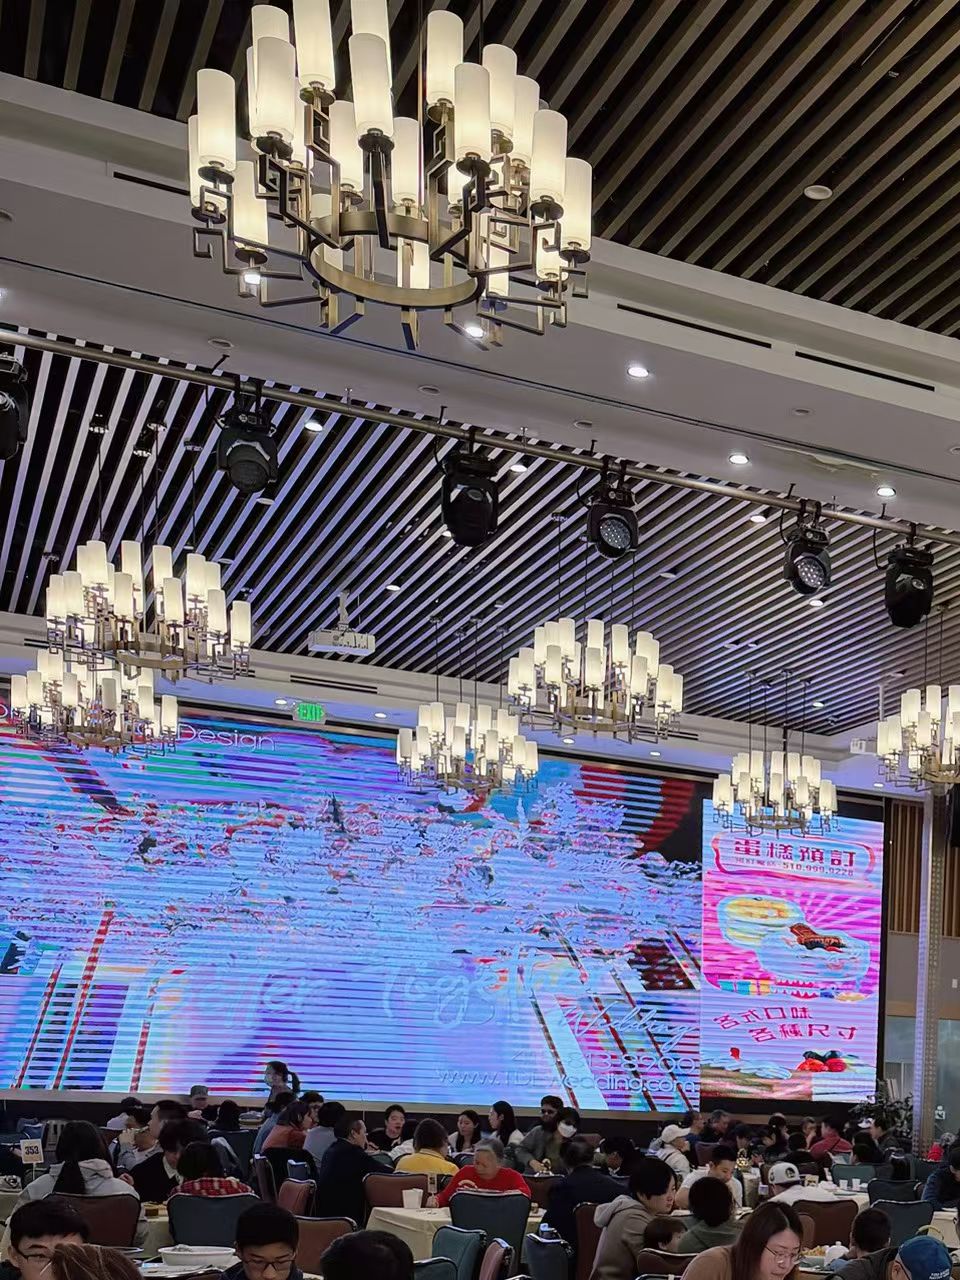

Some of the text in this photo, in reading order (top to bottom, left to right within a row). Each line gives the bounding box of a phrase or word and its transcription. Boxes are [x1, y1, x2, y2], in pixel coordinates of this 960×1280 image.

[299, 702, 322, 722] EXIT
[176, 723, 276, 752] Design
[734, 838, 857, 867] 蛋糕預訂
[561, 1000, 699, 1053] Wedding
[713, 1006, 814, 1030] 各式口味
[747, 1023, 859, 1043] 各種尺寸
[25, 1146, 39, 1155] 353
